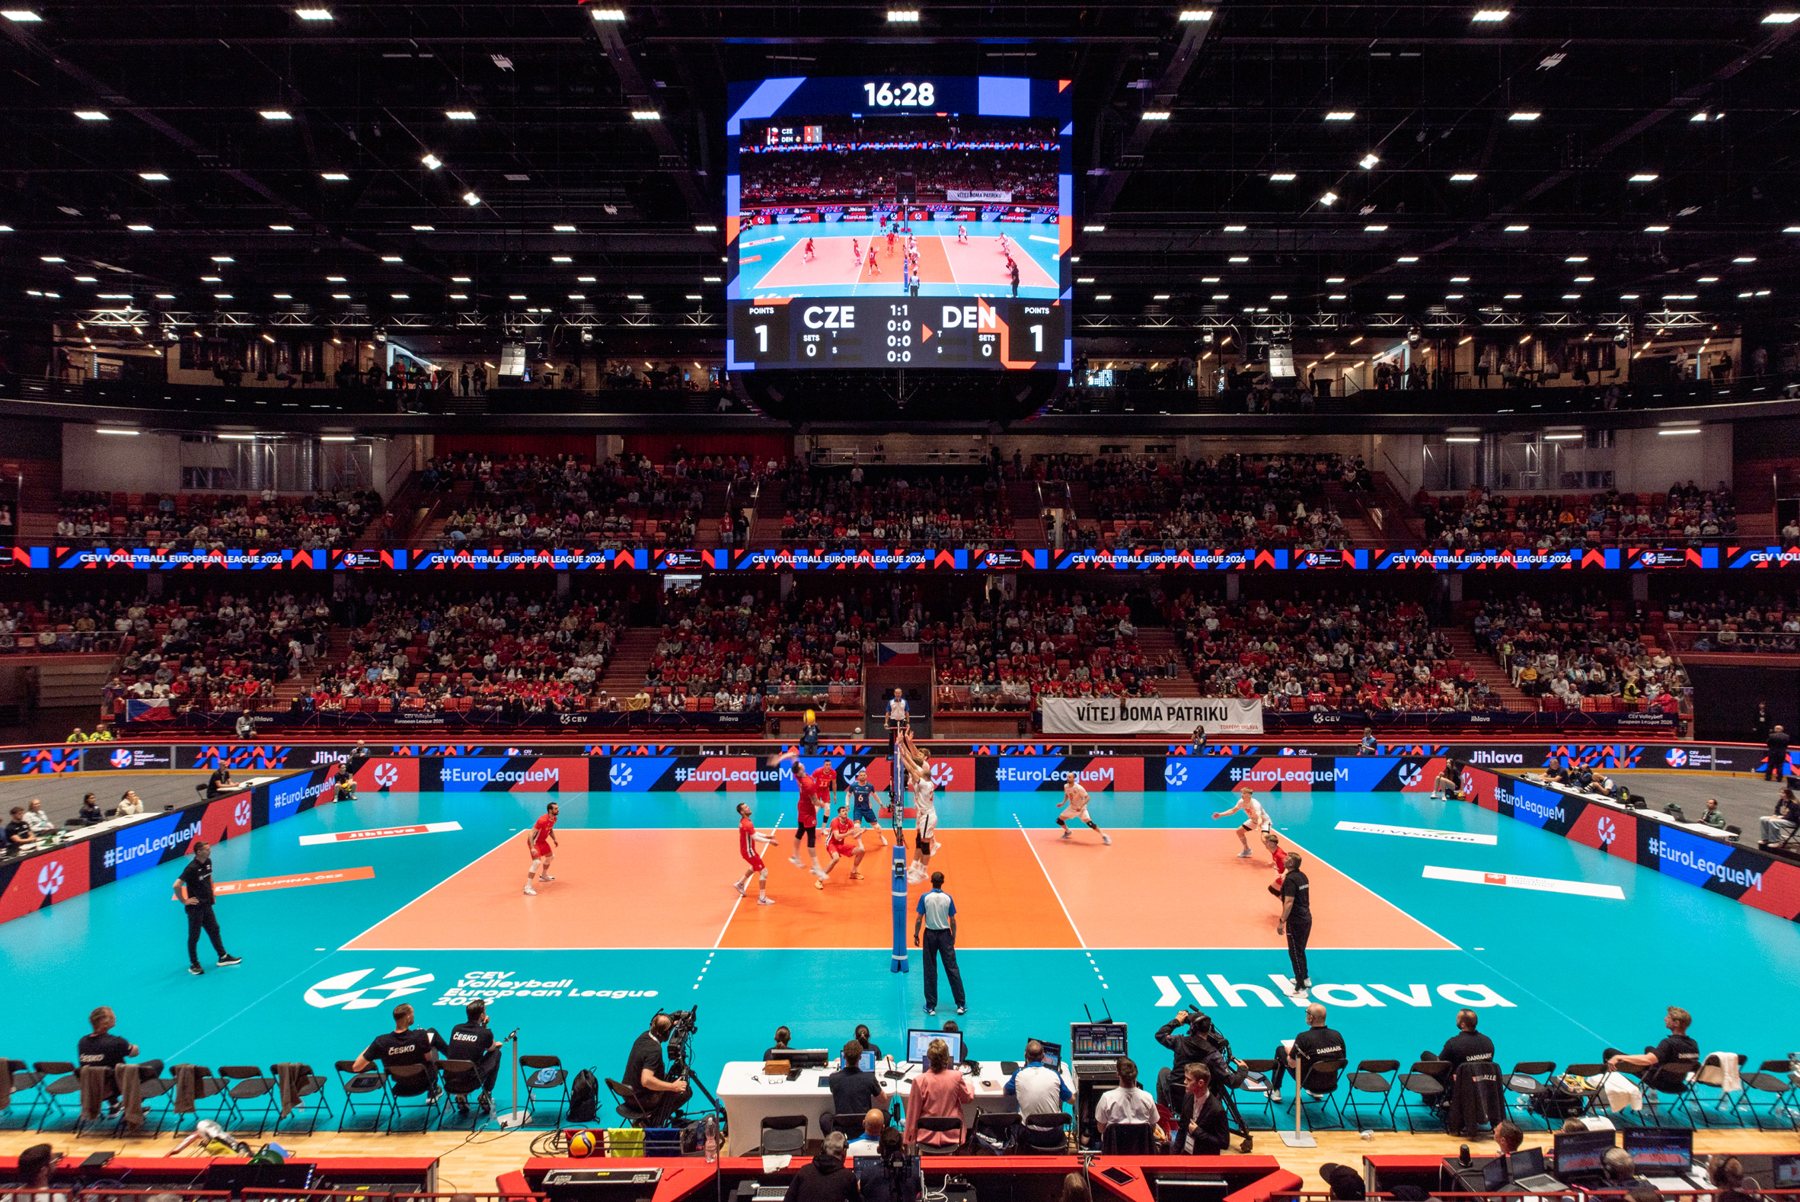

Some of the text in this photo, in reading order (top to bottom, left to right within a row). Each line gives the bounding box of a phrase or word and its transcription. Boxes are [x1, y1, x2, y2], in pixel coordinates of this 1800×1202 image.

[864, 83, 935, 106] 16:28
[803, 306, 855, 328] CZE
[890, 305, 908, 316] 1:1
[942, 306, 996, 328] DEN
[887, 320, 911, 331] 0:0
[754, 325, 767, 352] 1
[887, 335, 911, 346] 0:0
[1030, 325, 1042, 352] 1
[806, 344, 816, 357] 0
[887, 350, 911, 362] 0:0
[982, 344, 992, 357] 0
[80, 554, 283, 564] CEV VOLLEYBALL EUROPEAN LEAGUE 2026
[432, 555, 606, 564] CEV VOLLEYBALL EUROPEAN LEAGUE 2026
[753, 555, 926, 564] CEV VOLLEYBALL EUROPEAN LEAGUE 2026
[1073, 555, 1246, 564] CEV VOLLEYBALL EUROPEAN LEAGUE 2026
[1393, 555, 1572, 564] CEV VOLLEYBALL EUROPEAN LEAGUE 2026
[1750, 553, 1774, 562] CEV
[1077, 703, 1228, 721] VÍTEJ DOMA PATRIKU
[1469, 750, 1523, 764] Jihlava
[440, 768, 559, 785] #EuroLeagueM
[675, 768, 794, 785] #EuroLeagueM
[996, 767, 1114, 785] #EuroLeagueM
[1230, 768, 1348, 785] #EuroLeagueM
[274, 776, 336, 808] #EuroLeagueM
[1494, 786, 1565, 823] #EuroLeagueM
[103, 821, 202, 868] #EuroLeagueM
[1649, 834, 1762, 891] #EuroLeagueM
[463, 971, 515, 979] CEV
[456, 979, 573, 989] Volleyball
[1152, 974, 1517, 1007] Jihlava
[444, 988, 659, 999] European League
[453, 1031, 478, 1042] ČESKO
[388, 1044, 416, 1056] ČESKO
[1317, 1045, 1342, 1055] DANMARK
